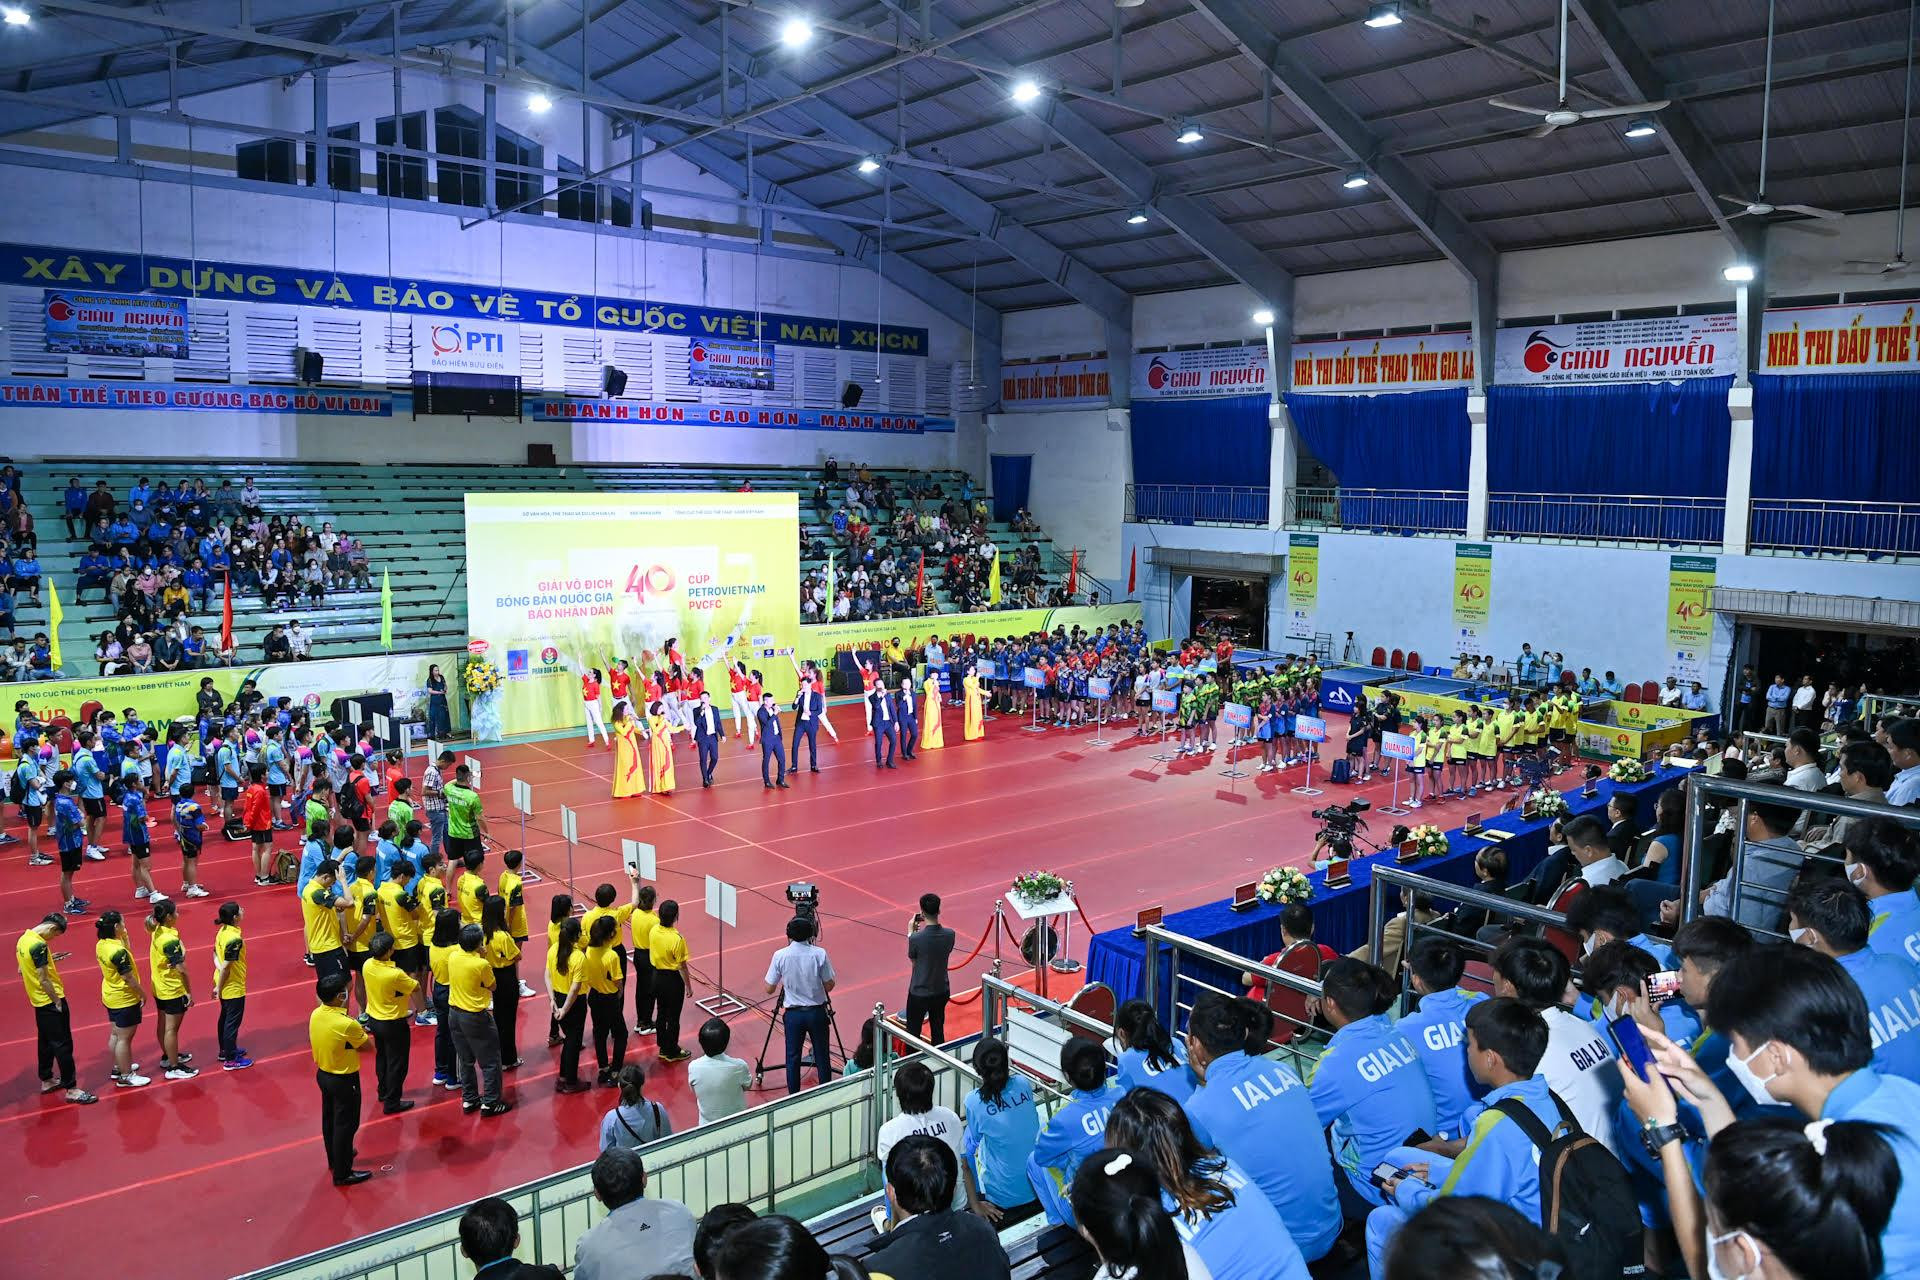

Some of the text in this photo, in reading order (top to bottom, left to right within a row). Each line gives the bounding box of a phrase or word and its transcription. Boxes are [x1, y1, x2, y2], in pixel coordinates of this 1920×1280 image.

[23, 256, 125, 284] XÂY
[150, 266, 276, 297] DỰNG
[296, 277, 353, 303] VÀ
[373, 282, 453, 310] BẢO
[536, 295, 582, 320] TỔ
[597, 305, 686, 329] QUỐC
[700, 314, 767, 339] VIỆT
[781, 322, 839, 343] NAM
[852, 329, 918, 349] XHCN
[467, 331, 503, 352] PTI
[1767, 320, 1799, 367] NHÀ
[1804, 329, 1834, 366] THI
[1875, 306, 1913, 363] THỂ
[432, 358, 447, 368] BẢO
[1294, 351, 1313, 386] NHÀ
[1316, 358, 1333, 385] THI
[1357, 341, 1380, 383] THỂ
[1380, 353, 1408, 382] THAO
[1411, 340, 1438, 382] TỈNH
[1440, 350, 1459, 381] GIA
[1561, 346, 1609, 370] GIÀU
[1624, 336, 1715, 368] NGUYỄN
[1, 385, 60, 402] THÂN
[68, 384, 108, 403] THỂ
[115, 388, 167, 405] THEO
[174, 389, 242, 407] GƯƠNG
[250, 391, 288, 409] BÁC
[294, 391, 319, 410] HỒ
[349, 397, 380, 413] ĐẠI
[545, 402, 918, 431] NHANH HƠN CAO HƠN MẠNH HƠN
[625, 563, 676, 605] 40
[688, 571, 710, 584] CÚP
[688, 584, 766, 597] PETROVIETNAM
[496, 590, 614, 608] BÓNG BÀN QUỐC GIA
[528, 603, 614, 620] BÁO NHÂN DÂN
[688, 600, 722, 610] PVCFC
[111, 685, 131, 693] THAO
[1423, 1021, 1464, 1051] GIA
[1869, 1004, 1911, 1050] IA
[1356, 1047, 1403, 1083] GIA
[1570, 1042, 1595, 1072] GIA
[986, 1090, 1031, 1116] GIA LAI
[931, 1121, 947, 1137] LAI
